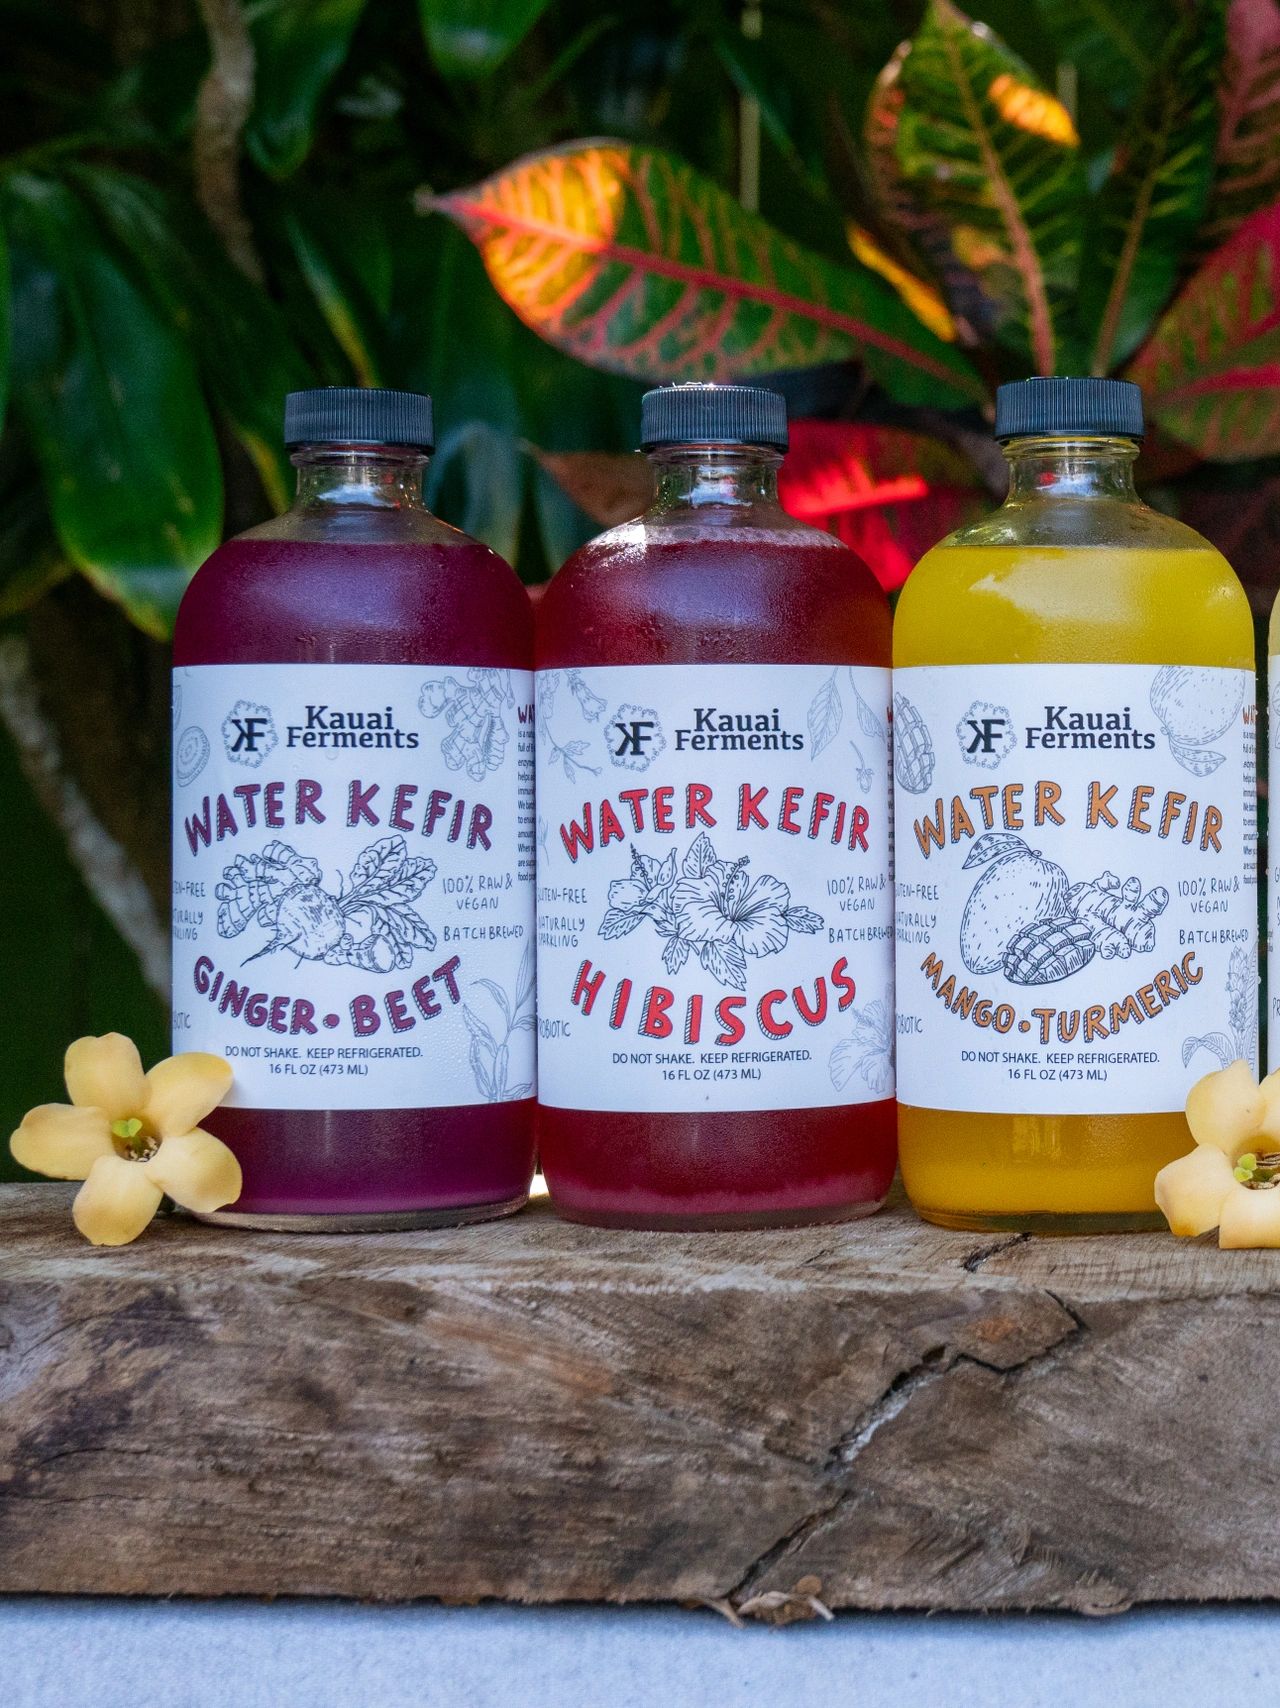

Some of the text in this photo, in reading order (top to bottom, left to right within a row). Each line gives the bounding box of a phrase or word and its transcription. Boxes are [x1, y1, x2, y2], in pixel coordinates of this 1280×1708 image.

[305, 705, 394, 730] Kauai
[693, 708, 780, 732] Kauai
[1044, 705, 1131, 730] Kauai
[287, 726, 418, 749] Ferments
[675, 729, 804, 751] Ferments
[1025, 727, 1155, 749] Ferments
[184, 779, 326, 856] WATER
[346, 779, 493, 851] KEFIR
[560, 783, 716, 863] WATER
[737, 783, 869, 853] KEFIR
[913, 780, 1065, 860] WATER
[1086, 781, 1222, 853] KEFIR
[442, 872, 513, 895] 100% RAW &
[826, 875, 854, 896] 100%
[858, 874, 878, 892] RAW
[1177, 875, 1240, 897] 100% RAW &
[456, 895, 499, 911] VEGAN
[839, 897, 875, 912] VEGAN
[1190, 898, 1229, 914] VEGAN
[897, 911, 937, 929] ATURALLY
[194, 955, 461, 1037] GINGER BEET
[571, 956, 856, 1047] HIBISCUS
[919, 951, 1203, 1045] MANGO TURMERIC
[225, 1045, 424, 1059] DO NOT SHAKE. KEEP REFRIGERATED.
[612, 1049, 813, 1065] DO NOT SHAKE. KEEP REFRIGERATED.
[961, 1050, 1160, 1065] DO NOT SHAKE. KEEP REFRIGERATED.
[269, 1063, 369, 1077] 16 FL OZ (473 ML)
[662, 1067, 762, 1082] 16 FL OZ (473 ML)
[1007, 1068, 1108, 1083] 16 FL OZ (473 ML)
